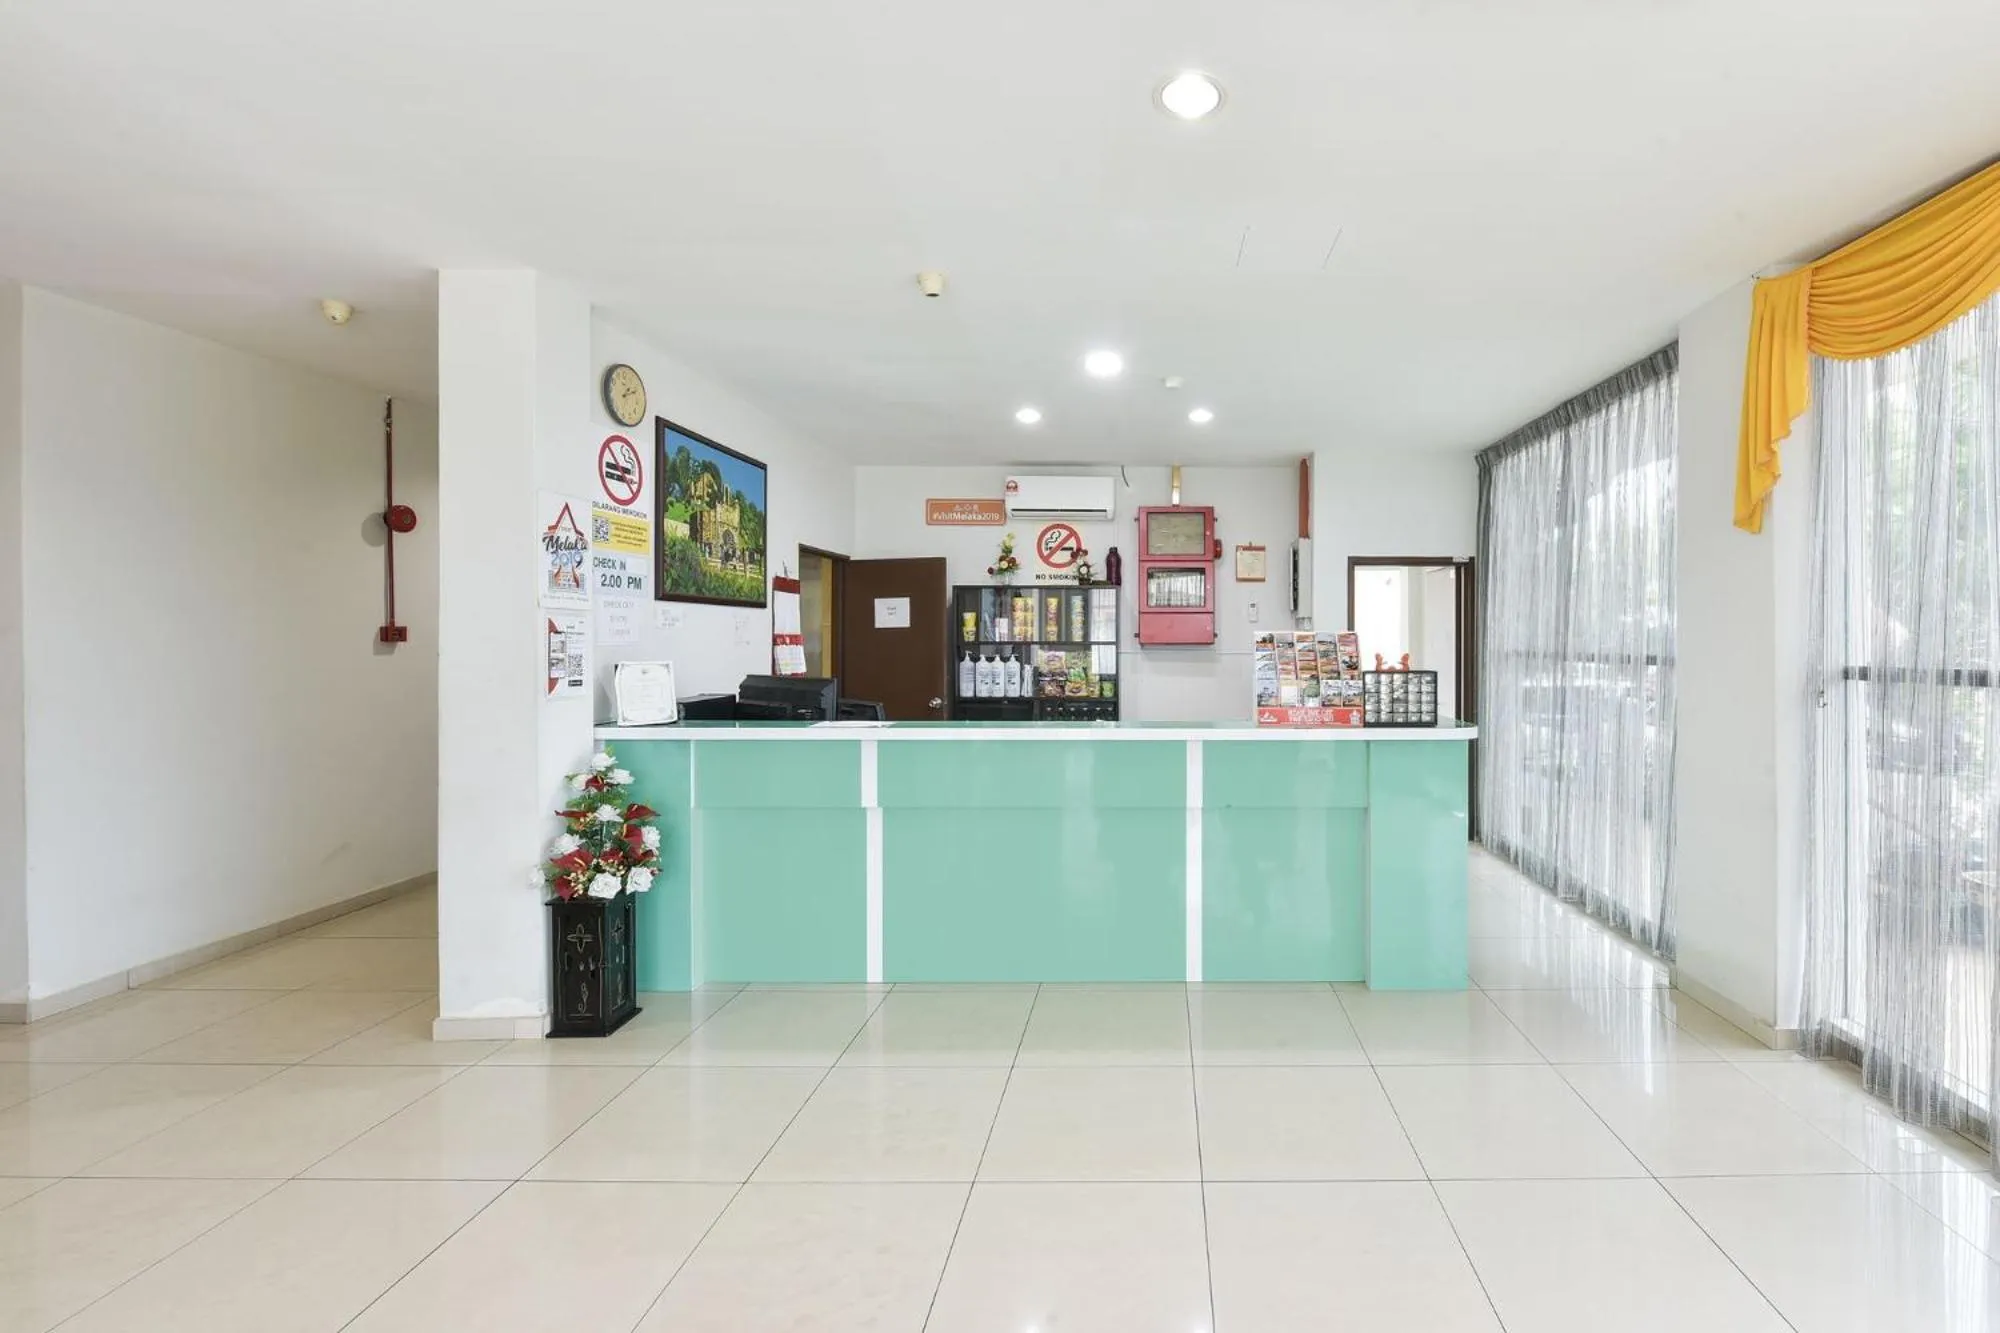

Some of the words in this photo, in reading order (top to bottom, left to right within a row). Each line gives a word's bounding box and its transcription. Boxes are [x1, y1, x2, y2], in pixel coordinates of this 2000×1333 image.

[542, 535, 588, 552] Melaka
[551, 551, 584, 568] 2019
[593, 557, 617, 570] CHECK
[619, 561, 627, 571] IN
[601, 573, 622, 588] 2.00
[627, 575, 642, 590] PM
